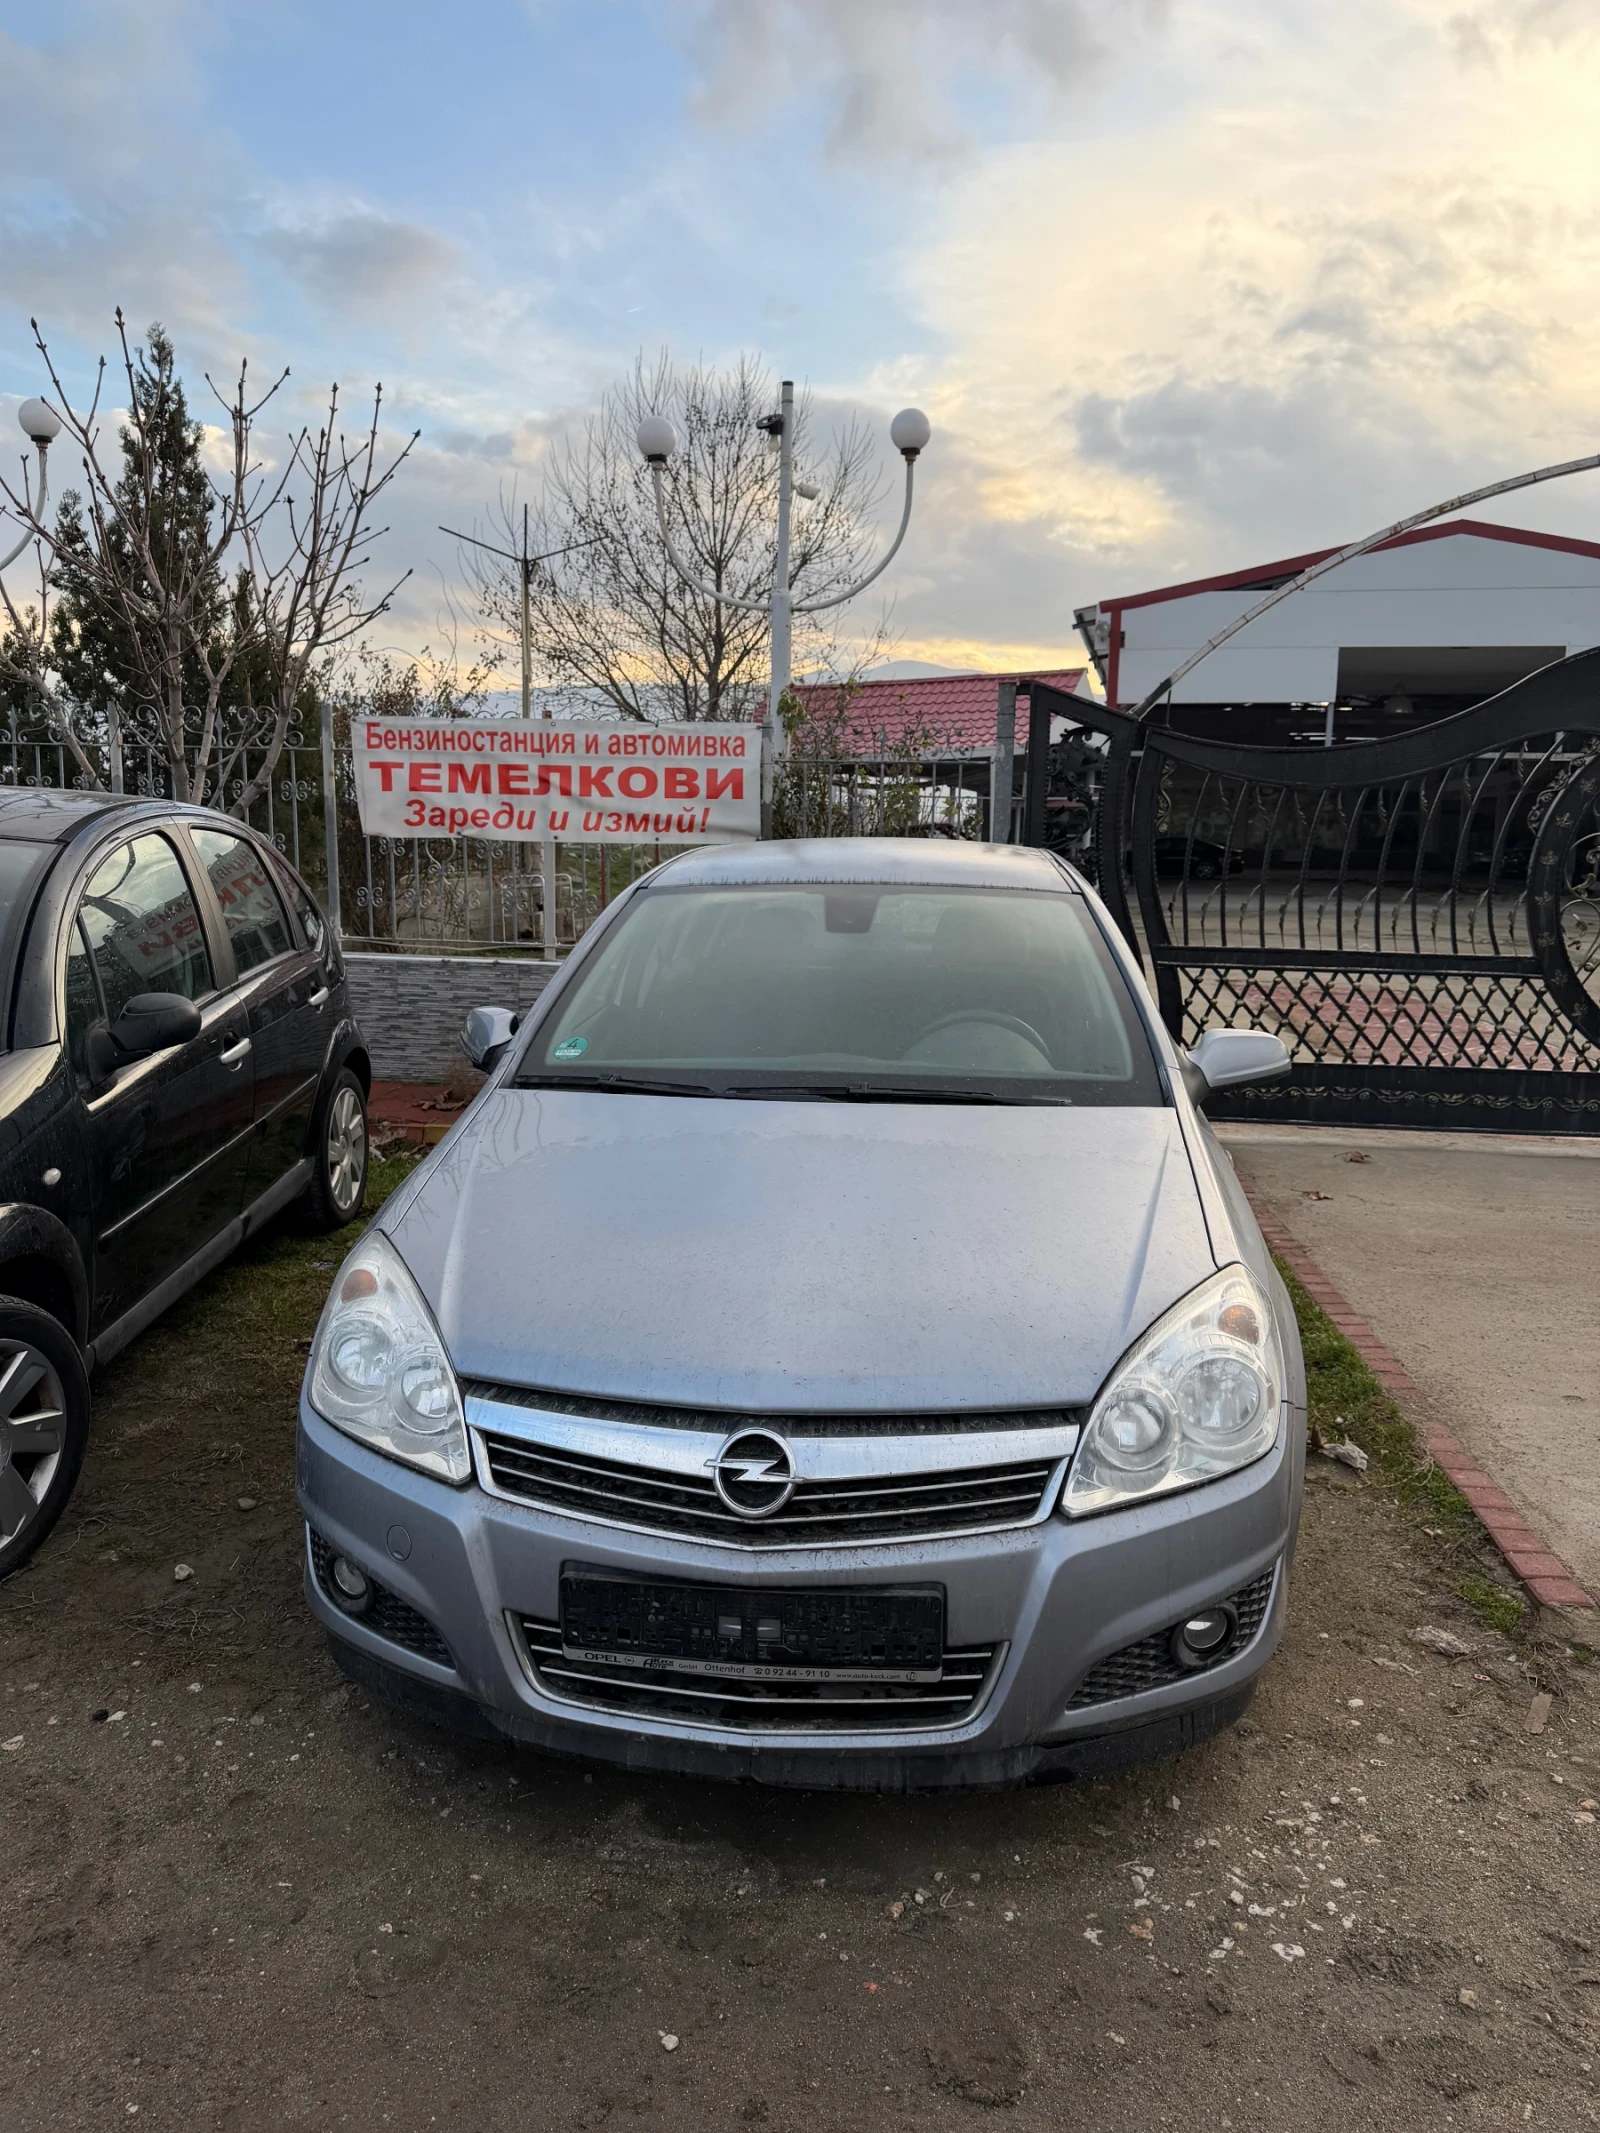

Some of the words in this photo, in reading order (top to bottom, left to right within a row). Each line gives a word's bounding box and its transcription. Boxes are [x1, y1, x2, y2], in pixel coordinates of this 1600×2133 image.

[366, 722, 575, 758] Бензиностанция
[585, 734, 599, 754] и
[608, 734, 746, 757] автомивка
[369, 761, 745, 800] ТЕМЕЛКОВИ
[403, 799, 536, 834] Зареди
[549, 810, 569, 831] и
[582, 807, 711, 833] измий!
[567, 1038, 579, 1049] 4
[584, 1652, 621, 1663] OPEL
[704, 1663, 746, 1674] Ottenhof
[773, 1668, 784, 1676] 92
[786, 1668, 797, 1676] 44
[805, 1669, 815, 1677] 91
[820, 1670, 830, 1678] 10
